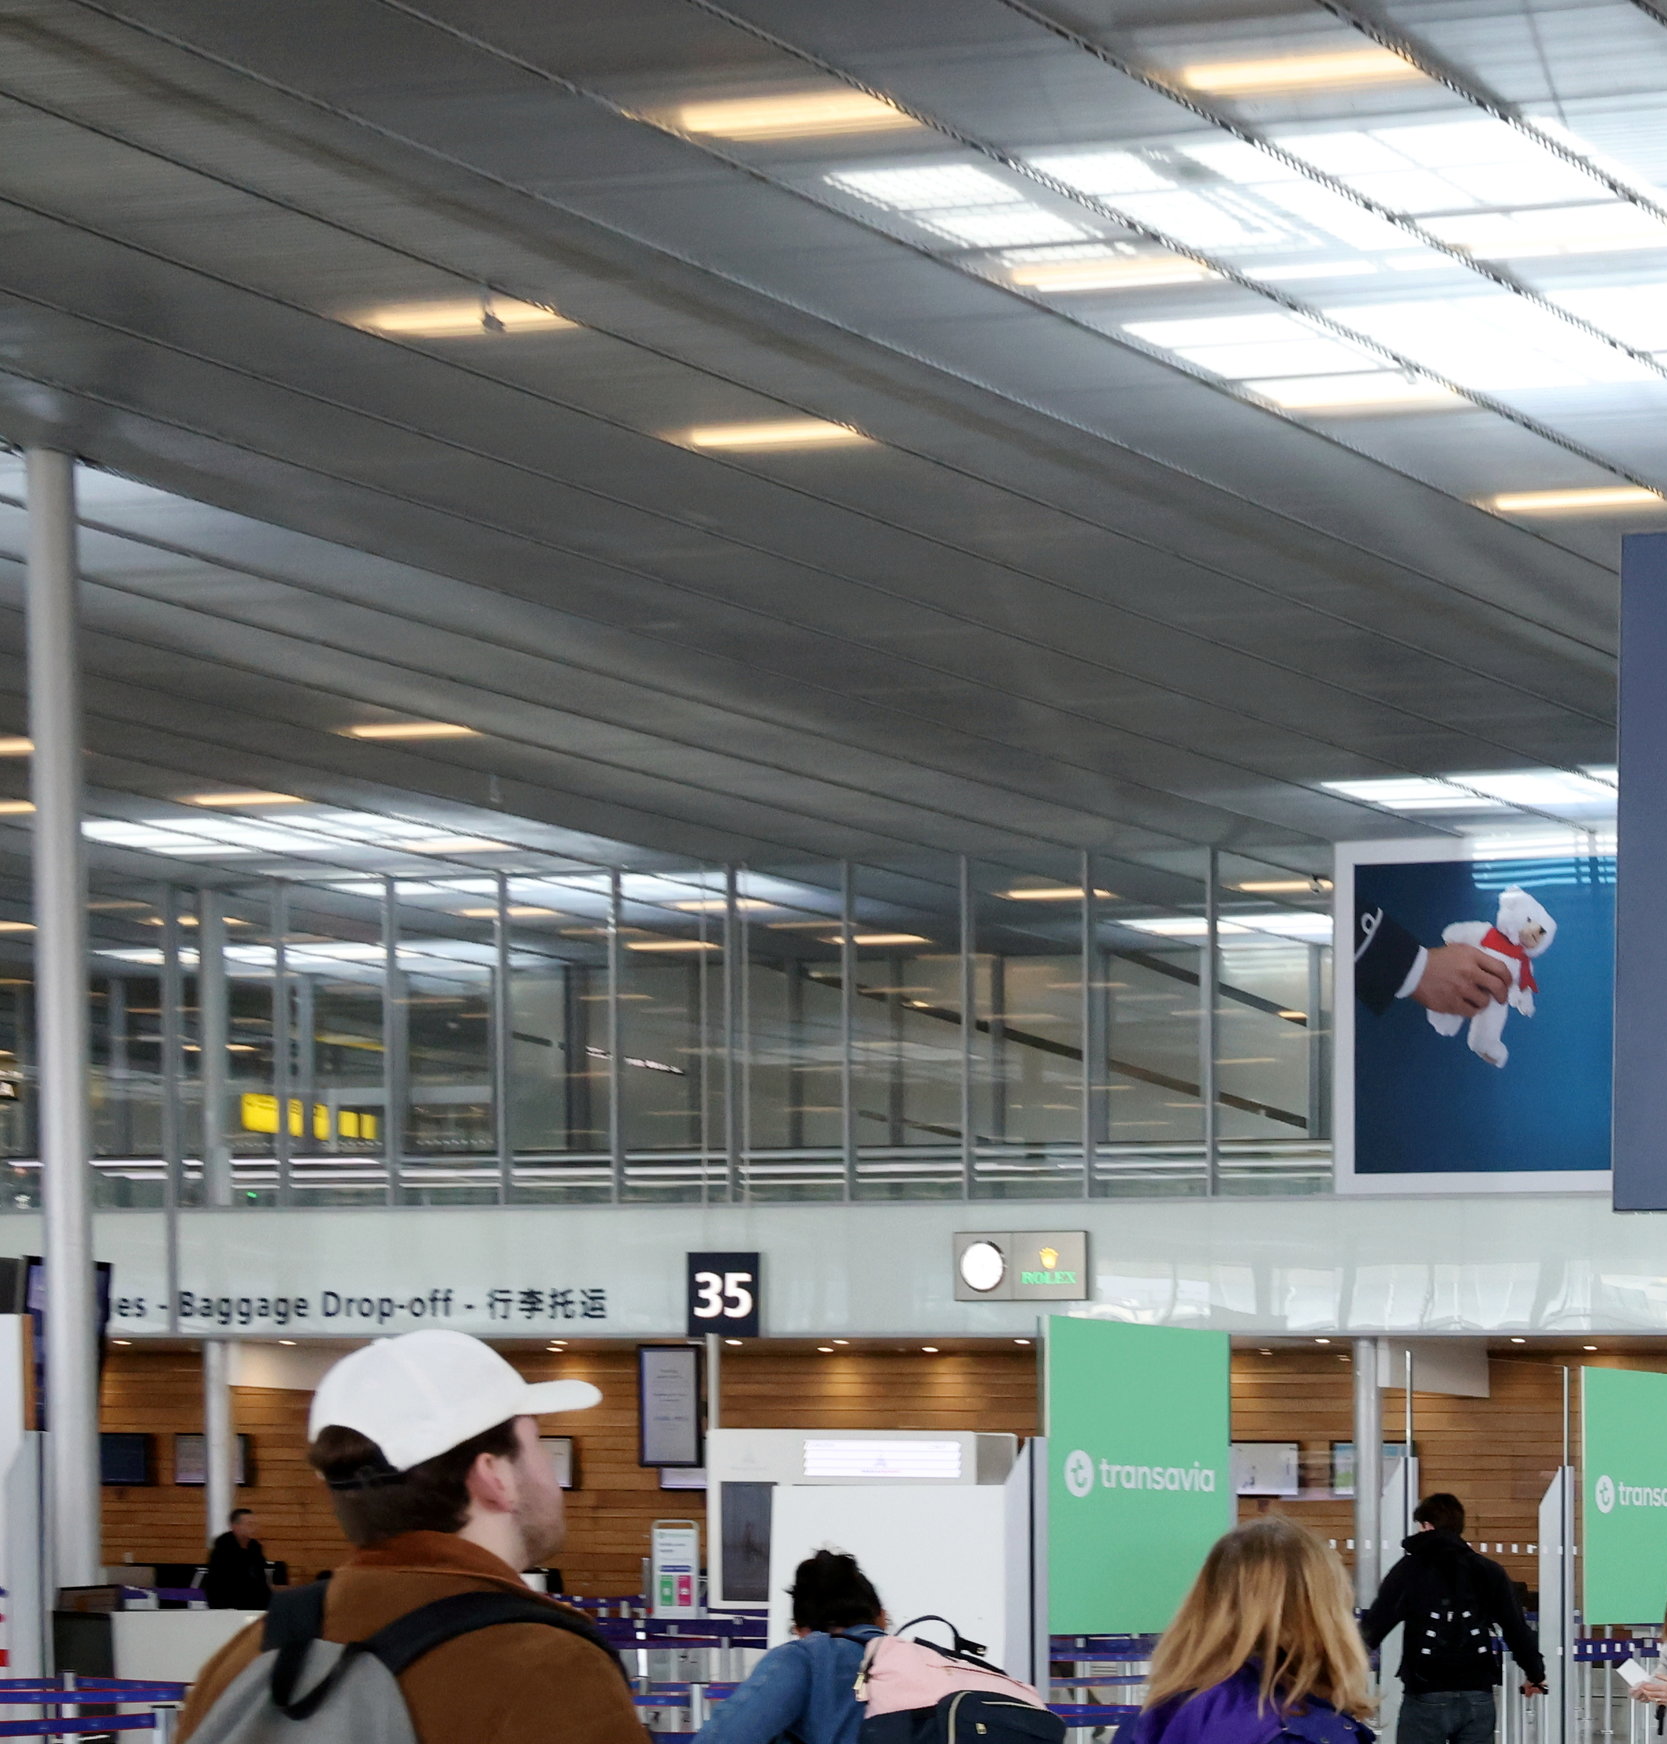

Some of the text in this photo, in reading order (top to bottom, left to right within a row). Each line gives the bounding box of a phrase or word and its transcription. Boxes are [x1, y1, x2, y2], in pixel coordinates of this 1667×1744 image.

[693, 1272, 754, 1319] 35
[1021, 1271, 1077, 1285] ROLEX
[178, 1291, 309, 1326] Baggage
[321, 1287, 454, 1325] Drop-off
[486, 1287, 608, 1320] 行李托运
[1100, 1458, 1215, 1492] transavia
